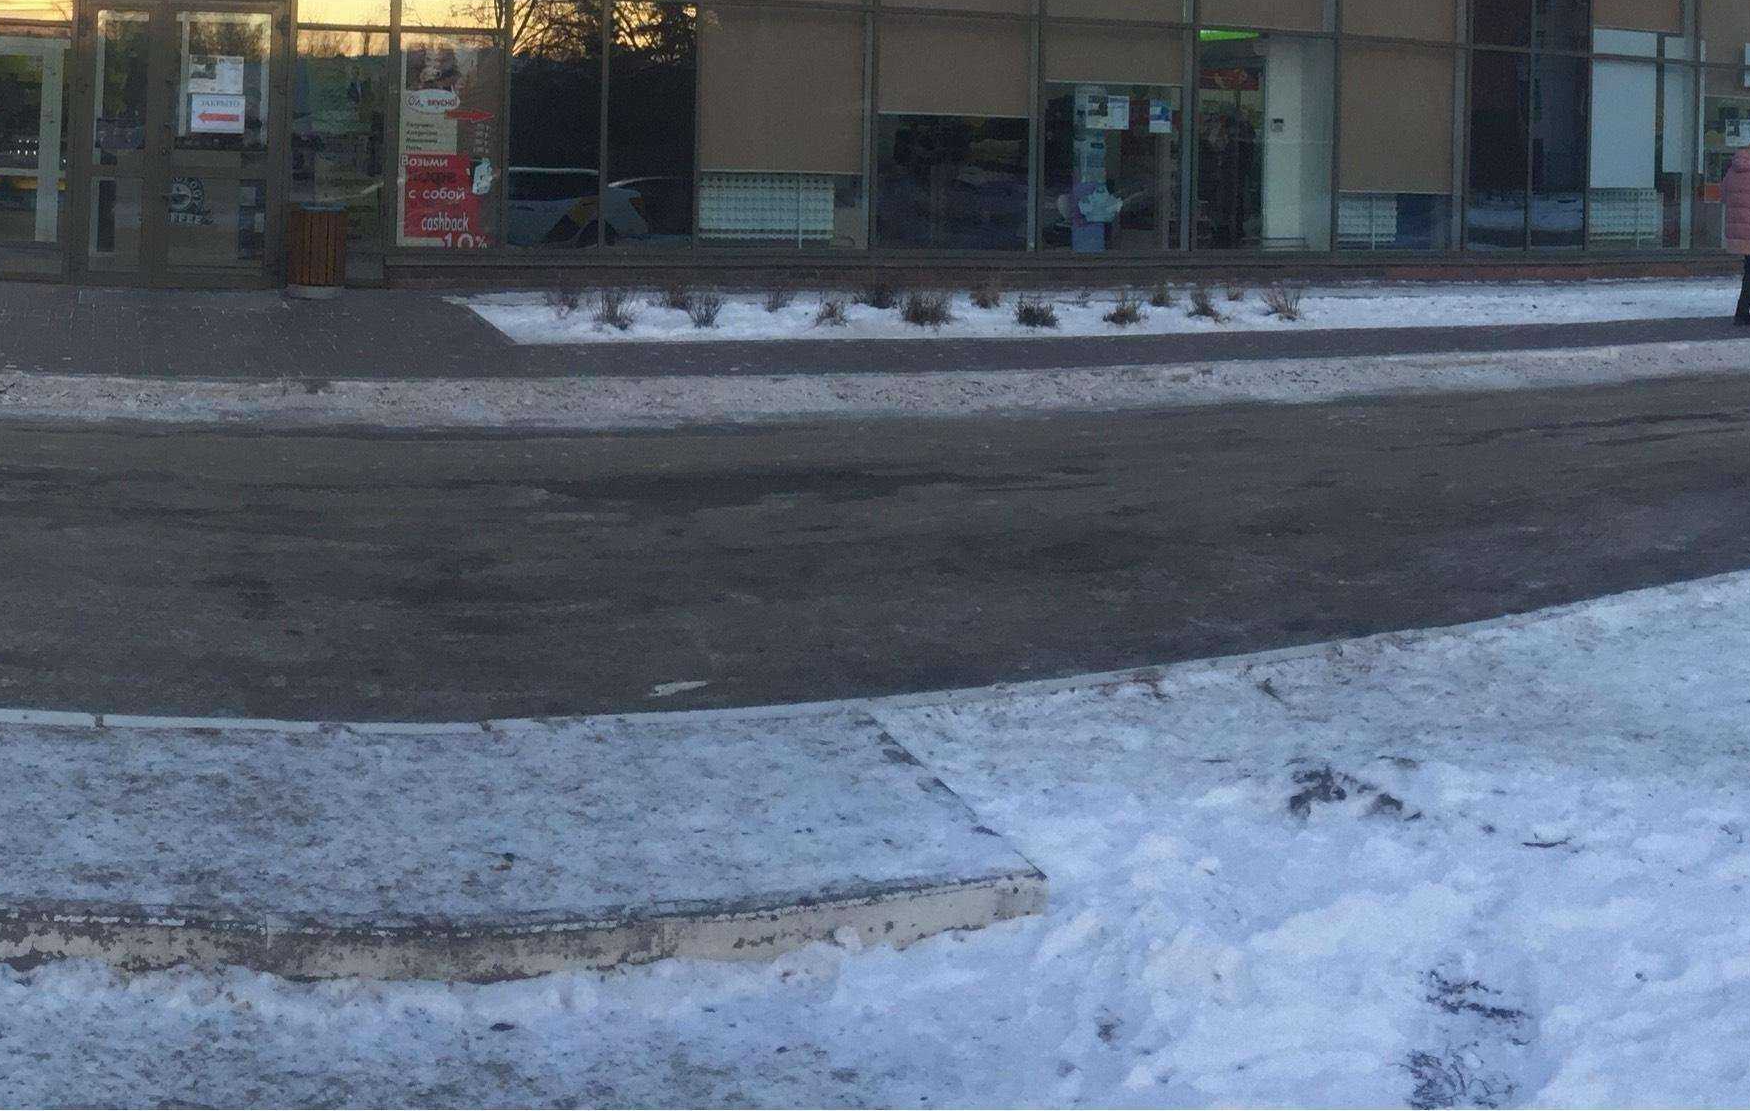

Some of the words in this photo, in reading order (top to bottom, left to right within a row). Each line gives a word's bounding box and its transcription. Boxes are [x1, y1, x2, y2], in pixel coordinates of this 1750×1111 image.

[401, 155, 449, 167] Возьми
[422, 186, 466, 199] собой
[421, 211, 469, 231] cashback
